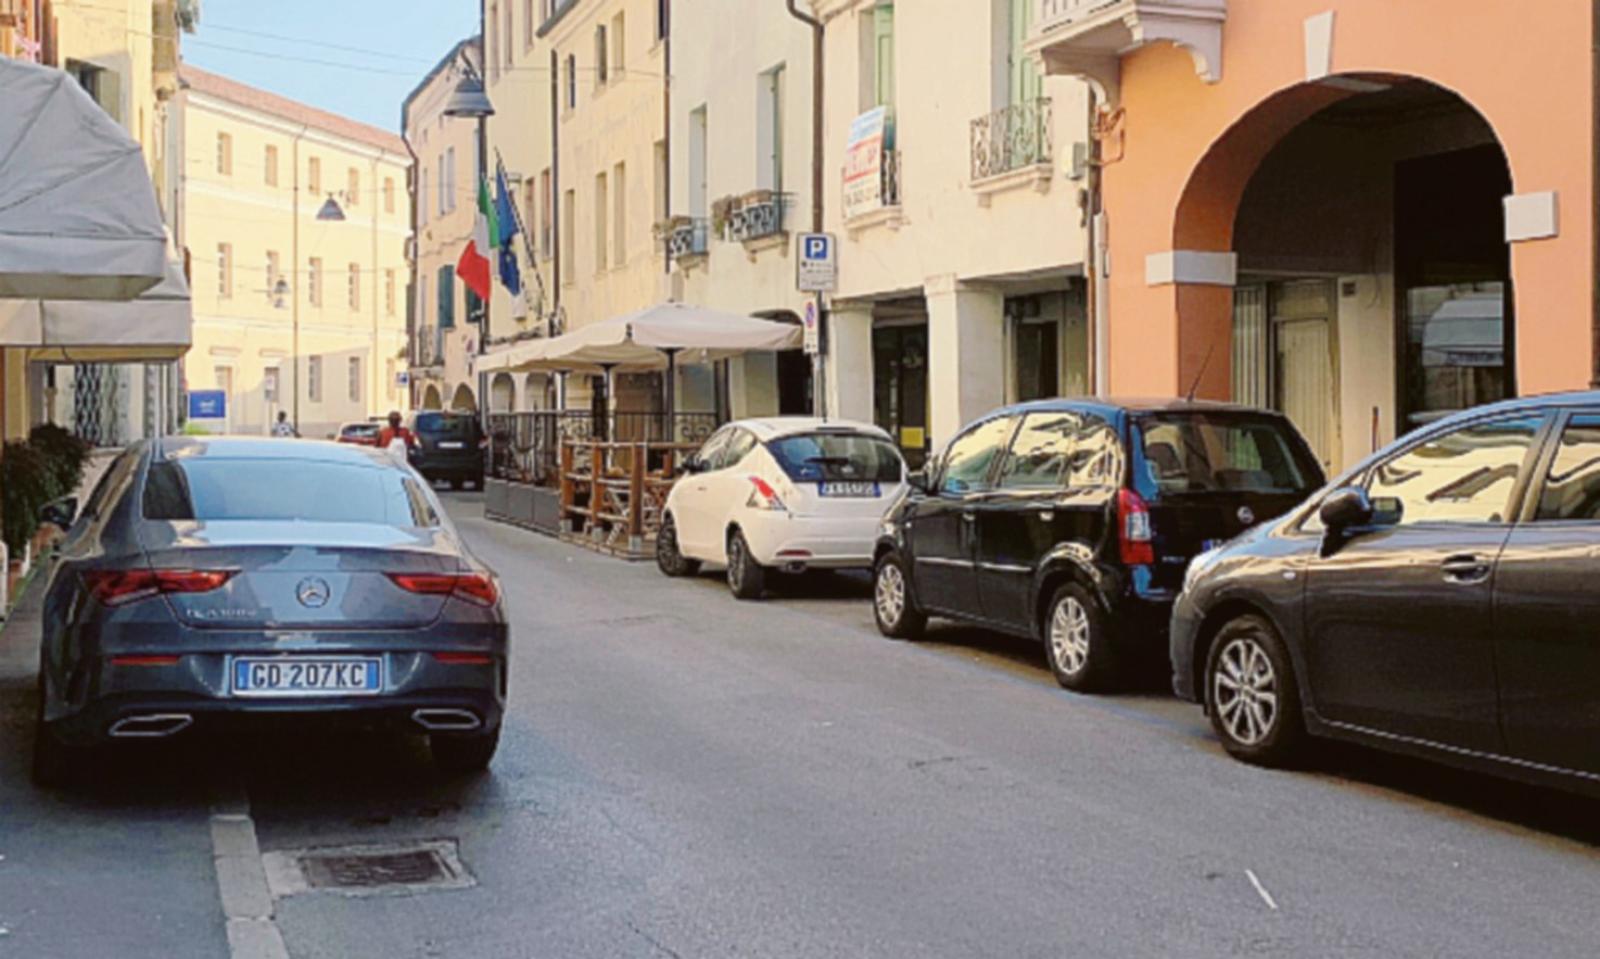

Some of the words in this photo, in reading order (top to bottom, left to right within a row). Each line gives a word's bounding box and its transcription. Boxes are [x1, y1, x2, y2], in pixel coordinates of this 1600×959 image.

[810, 239, 824, 258] P
[252, 664, 281, 687] GD
[289, 664, 364, 687] 207KC
